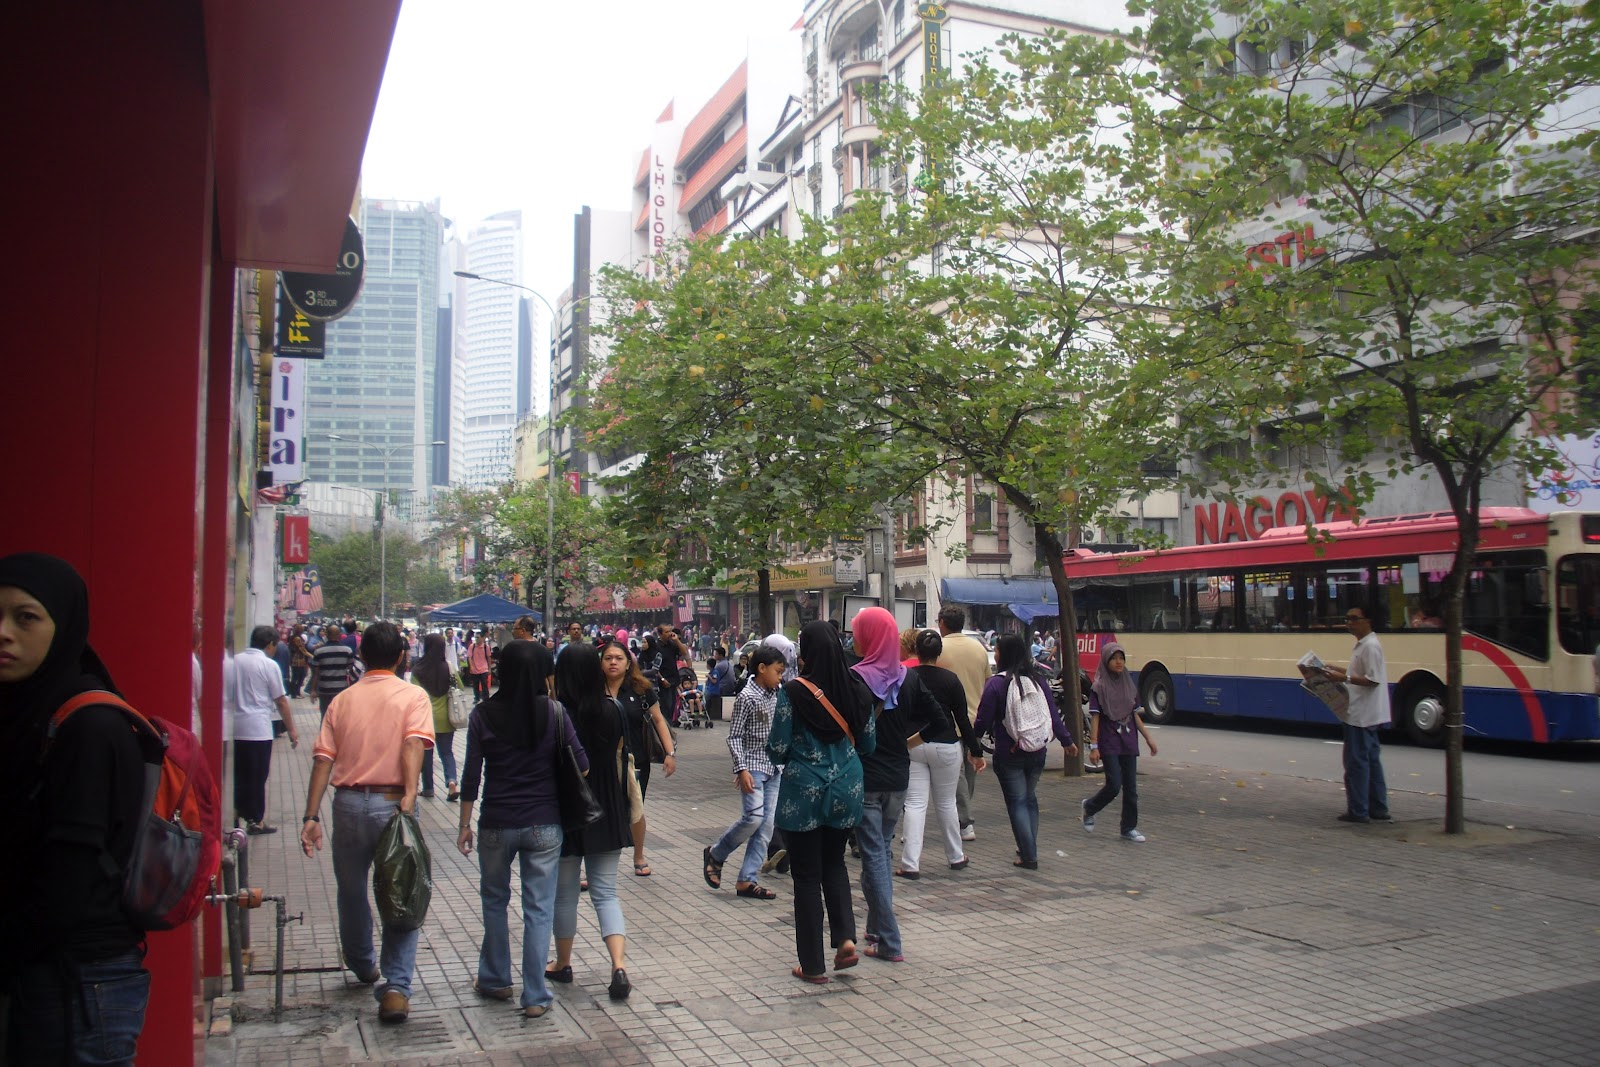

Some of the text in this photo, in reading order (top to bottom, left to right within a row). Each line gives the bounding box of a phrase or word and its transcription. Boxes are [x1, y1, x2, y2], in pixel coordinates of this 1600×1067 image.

[929, 32, 938, 88] HOTE
[317, 298, 338, 307] FLOOR
[1194, 485, 1358, 545] NAGOYA
[1076, 633, 1097, 654] pid
